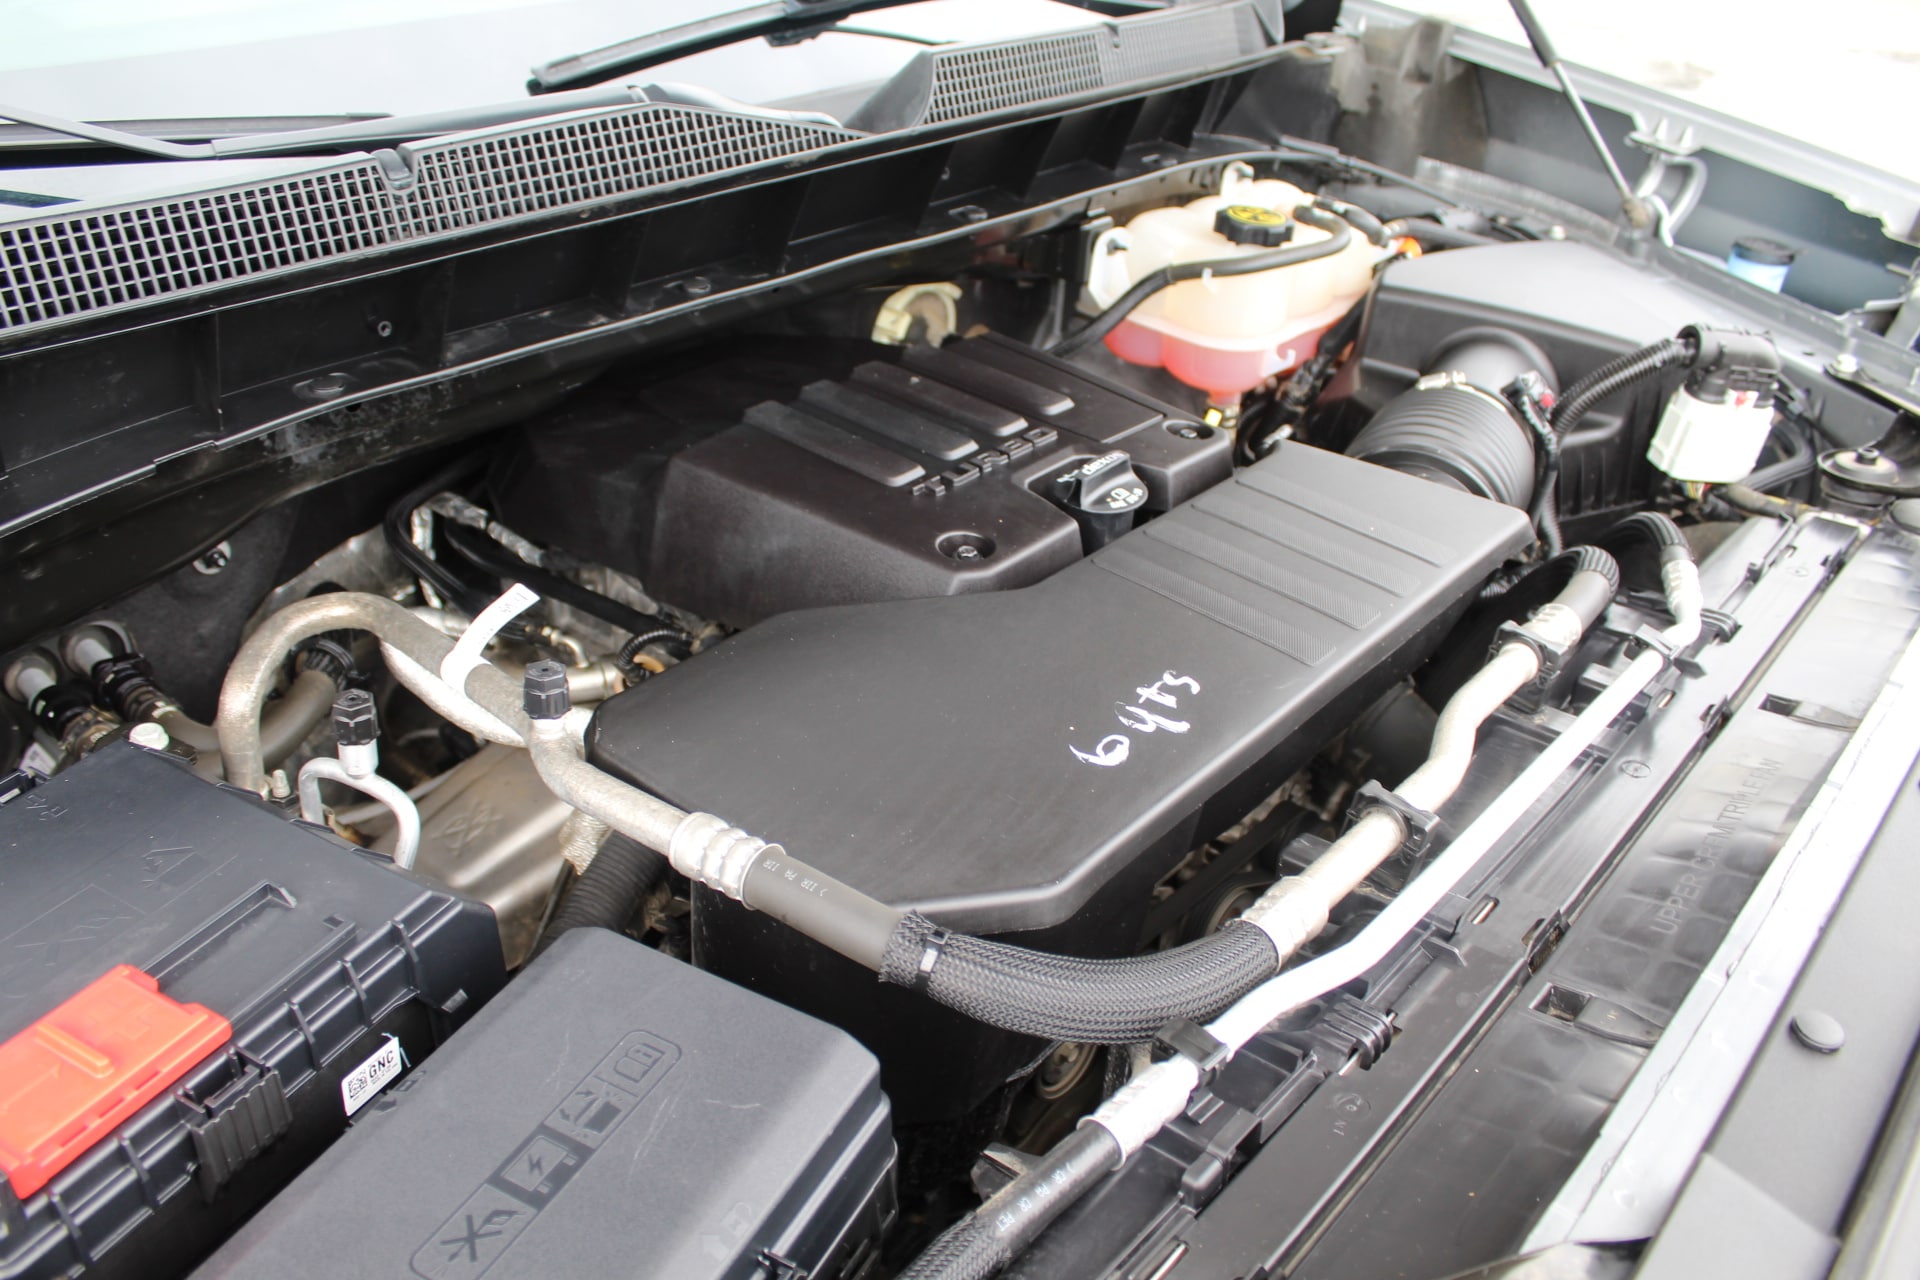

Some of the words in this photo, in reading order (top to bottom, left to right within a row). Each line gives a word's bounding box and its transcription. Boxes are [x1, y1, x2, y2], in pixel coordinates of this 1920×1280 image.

[912, 426, 1058, 497] TURBO
[1649, 873, 1706, 934] UPPER
[368, 1050, 394, 1079] GNC
